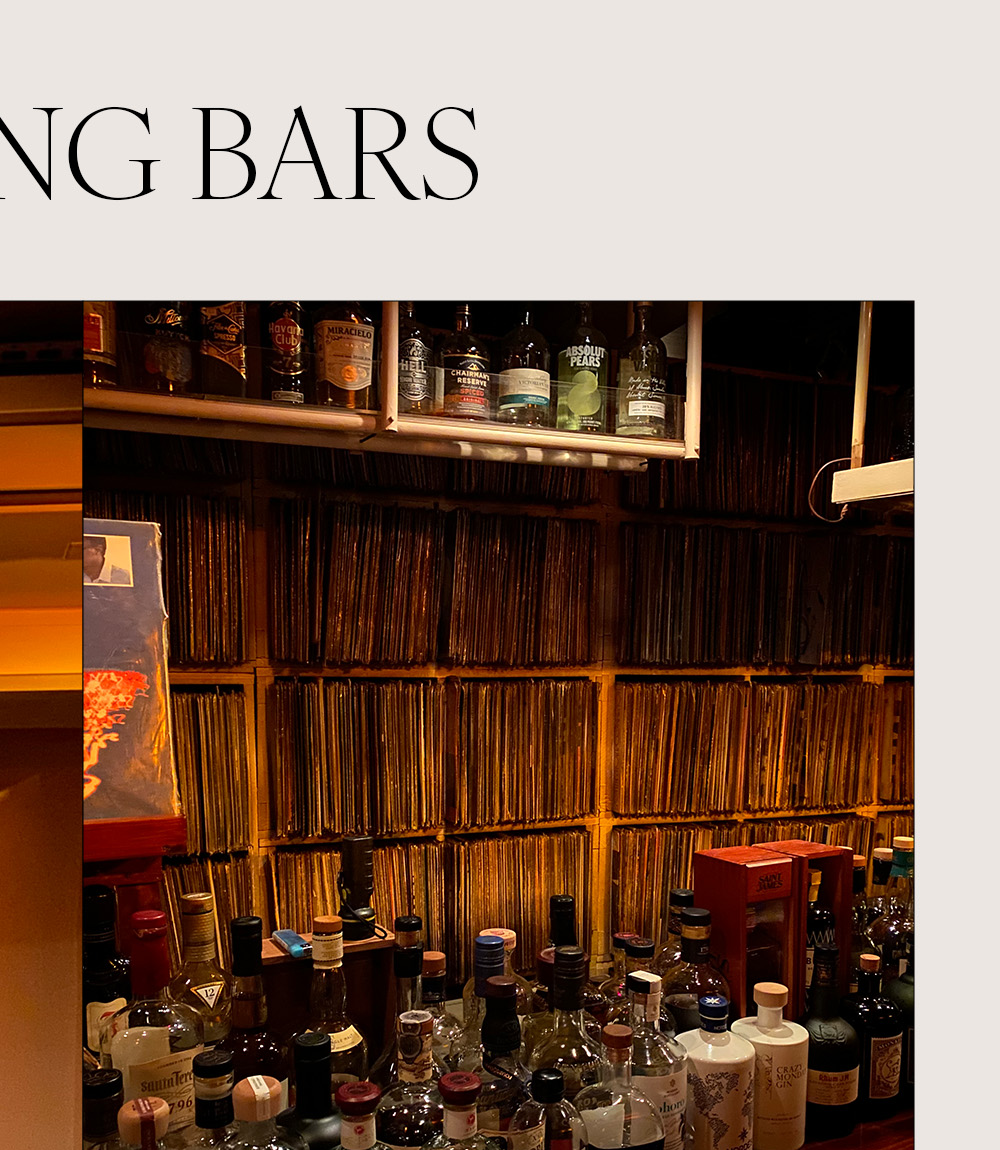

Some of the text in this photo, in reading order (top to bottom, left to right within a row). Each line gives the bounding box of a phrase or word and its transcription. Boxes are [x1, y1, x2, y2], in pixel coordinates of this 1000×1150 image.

[268, 322, 304, 337] Havana
[326, 327, 372, 340] MIRACIELO
[275, 334, 299, 347] Club
[565, 344, 606, 359] ABSOLUT
[570, 355, 601, 368] PEARS
[456, 377, 488, 388] RESERVE
[460, 387, 485, 397] SPICED
[205, 988, 215, 998] 12
[777, 1064, 803, 1075] CRAZY
[776, 1081, 793, 1089] GIN
[169, 1096, 193, 1115] 796
